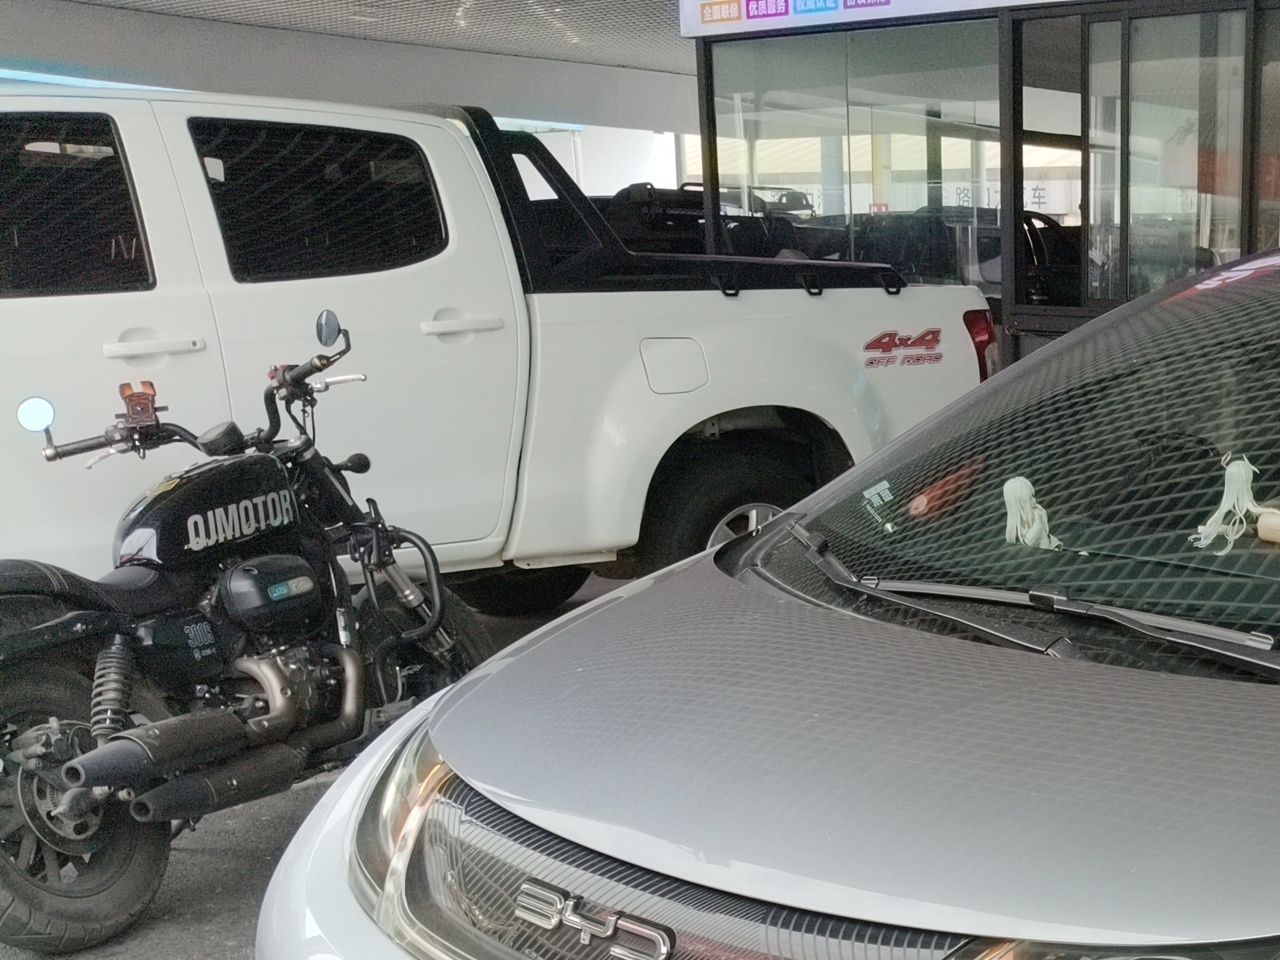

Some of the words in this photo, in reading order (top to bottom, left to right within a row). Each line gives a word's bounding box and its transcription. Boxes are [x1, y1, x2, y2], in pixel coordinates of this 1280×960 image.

[864, 356, 898, 368] OFF
[900, 353, 943, 368] ROAD
[184, 489, 294, 552] QJMOTOR
